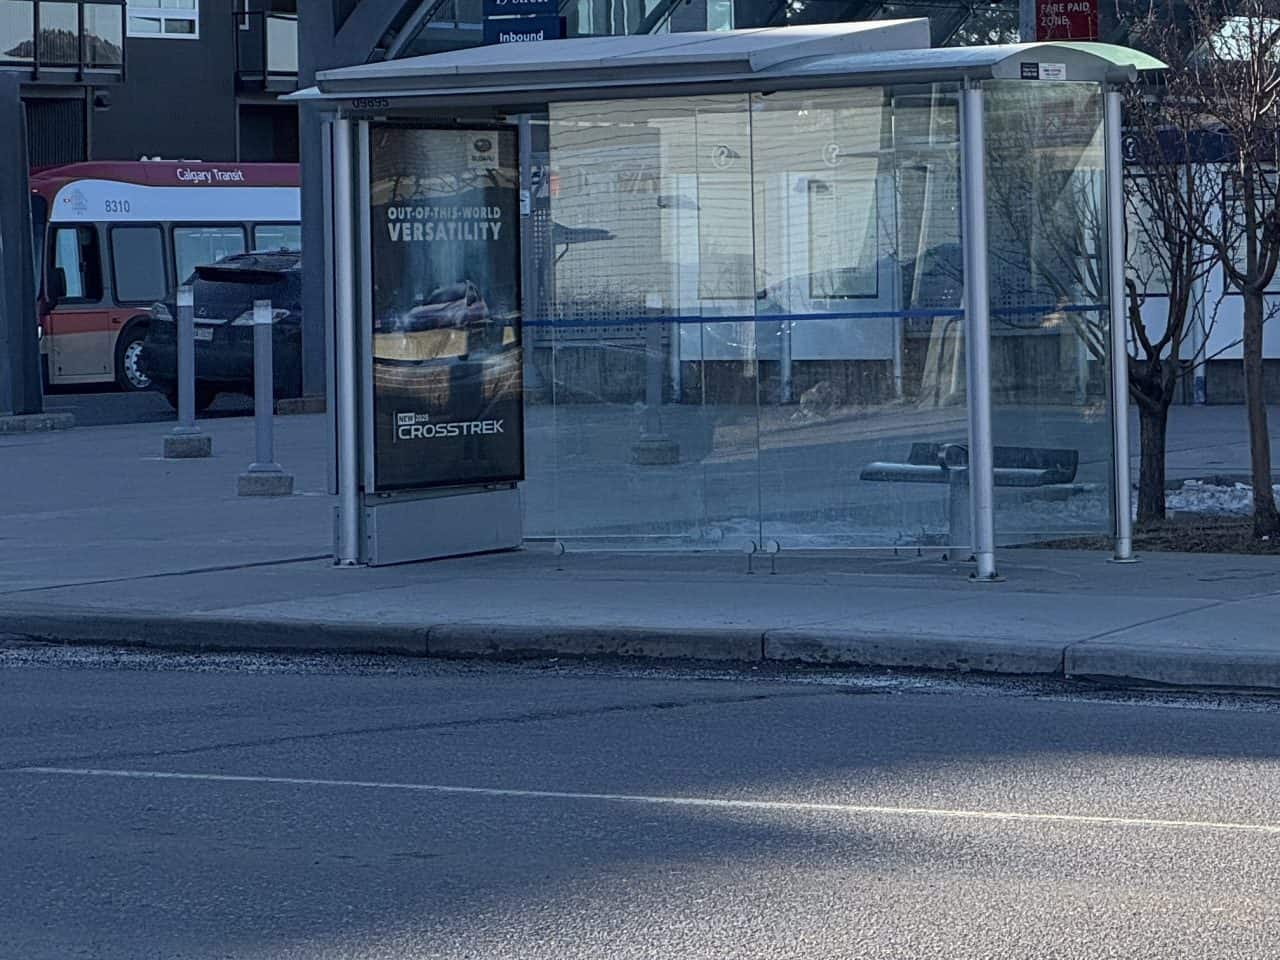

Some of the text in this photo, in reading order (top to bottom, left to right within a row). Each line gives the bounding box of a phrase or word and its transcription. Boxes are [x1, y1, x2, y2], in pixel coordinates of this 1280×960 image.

[1041, 1, 1091, 15] FARE PAID
[1041, 15, 1069, 26] ZONE
[499, 29, 544, 43] Inbound
[176, 168, 244, 184] Calgary Transit
[104, 199, 131, 214] 8310
[387, 222, 502, 242] VERSATILITY
[399, 414, 414, 424] NEW
[398, 420, 505, 440] CROSSTREK
